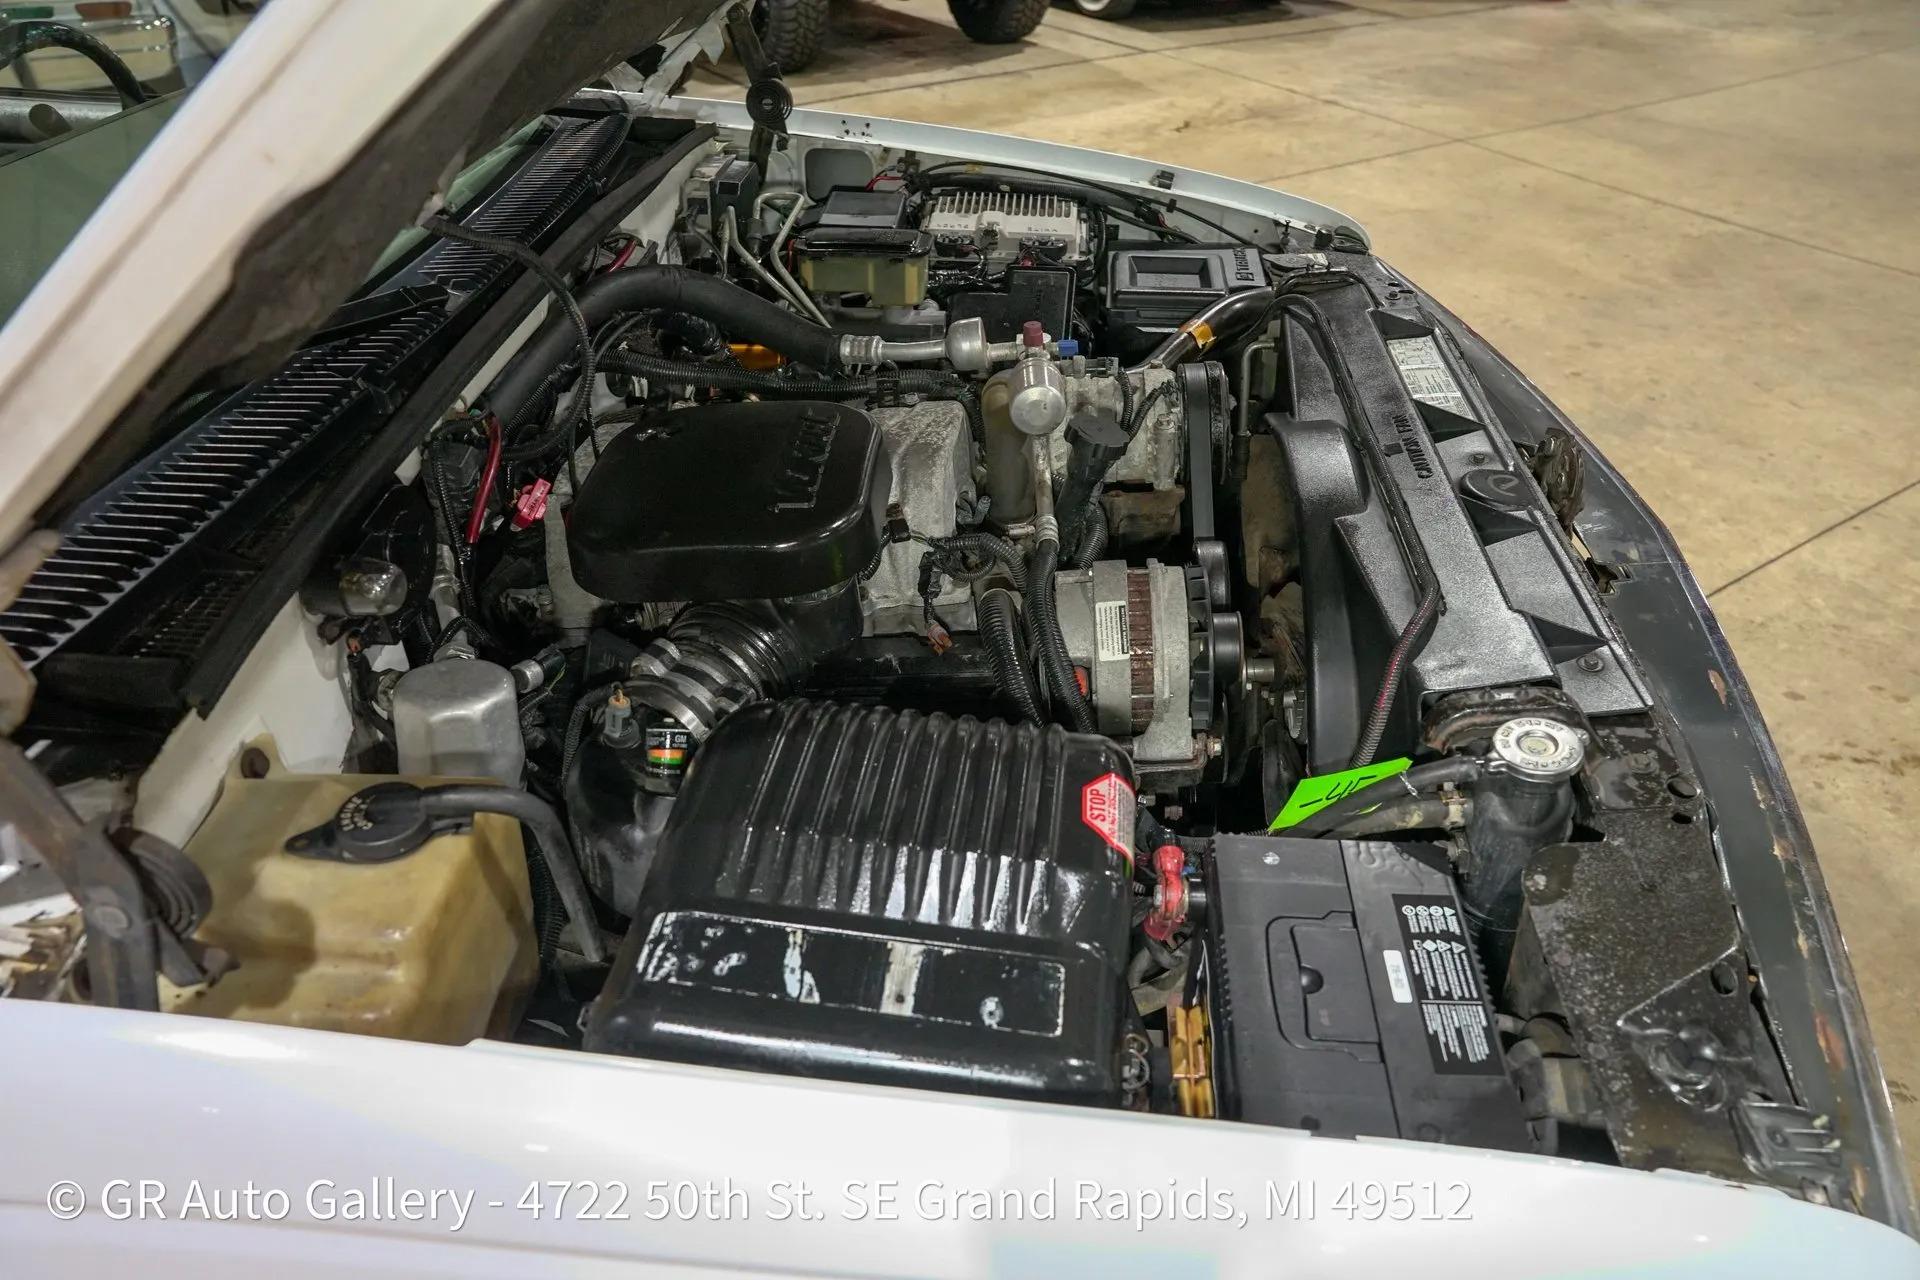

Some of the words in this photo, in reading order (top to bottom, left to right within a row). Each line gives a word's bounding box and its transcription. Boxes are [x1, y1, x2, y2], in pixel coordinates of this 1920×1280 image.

[1391, 414, 1413, 434] FAN
[1401, 436, 1434, 479] CAUTION
[674, 734, 687, 743] GM
[1089, 788, 1106, 822] STOP
